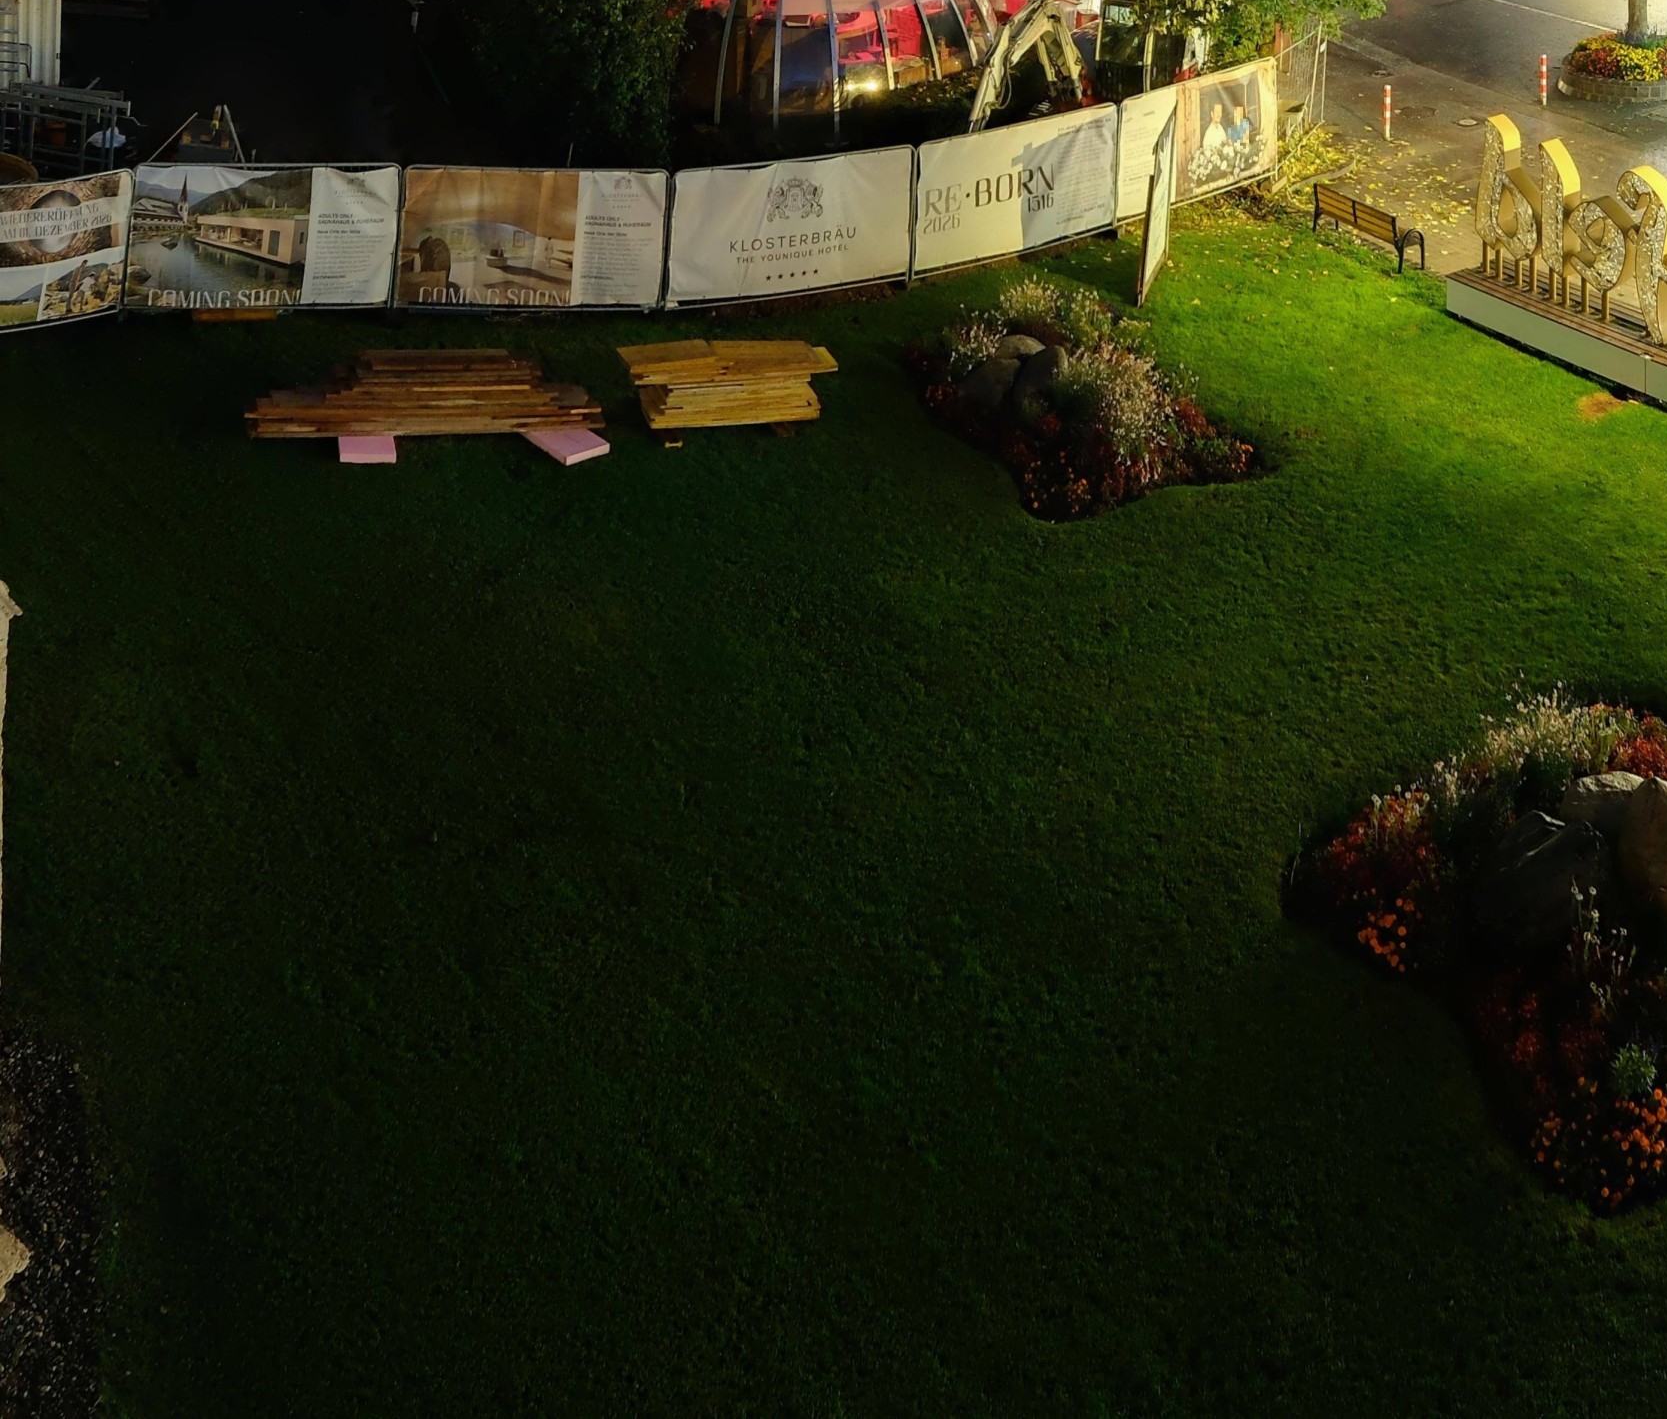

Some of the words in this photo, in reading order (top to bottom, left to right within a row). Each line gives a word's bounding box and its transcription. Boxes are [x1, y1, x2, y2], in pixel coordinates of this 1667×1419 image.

[1027, 192, 1054, 213] 1516
[923, 212, 961, 235] 2026
[729, 224, 857, 253] KLOSTERBRÄU
[736, 256, 755, 264] THE
[761, 251, 813, 262] YOUNIQUE
[818, 243, 849, 254] HOTEL
